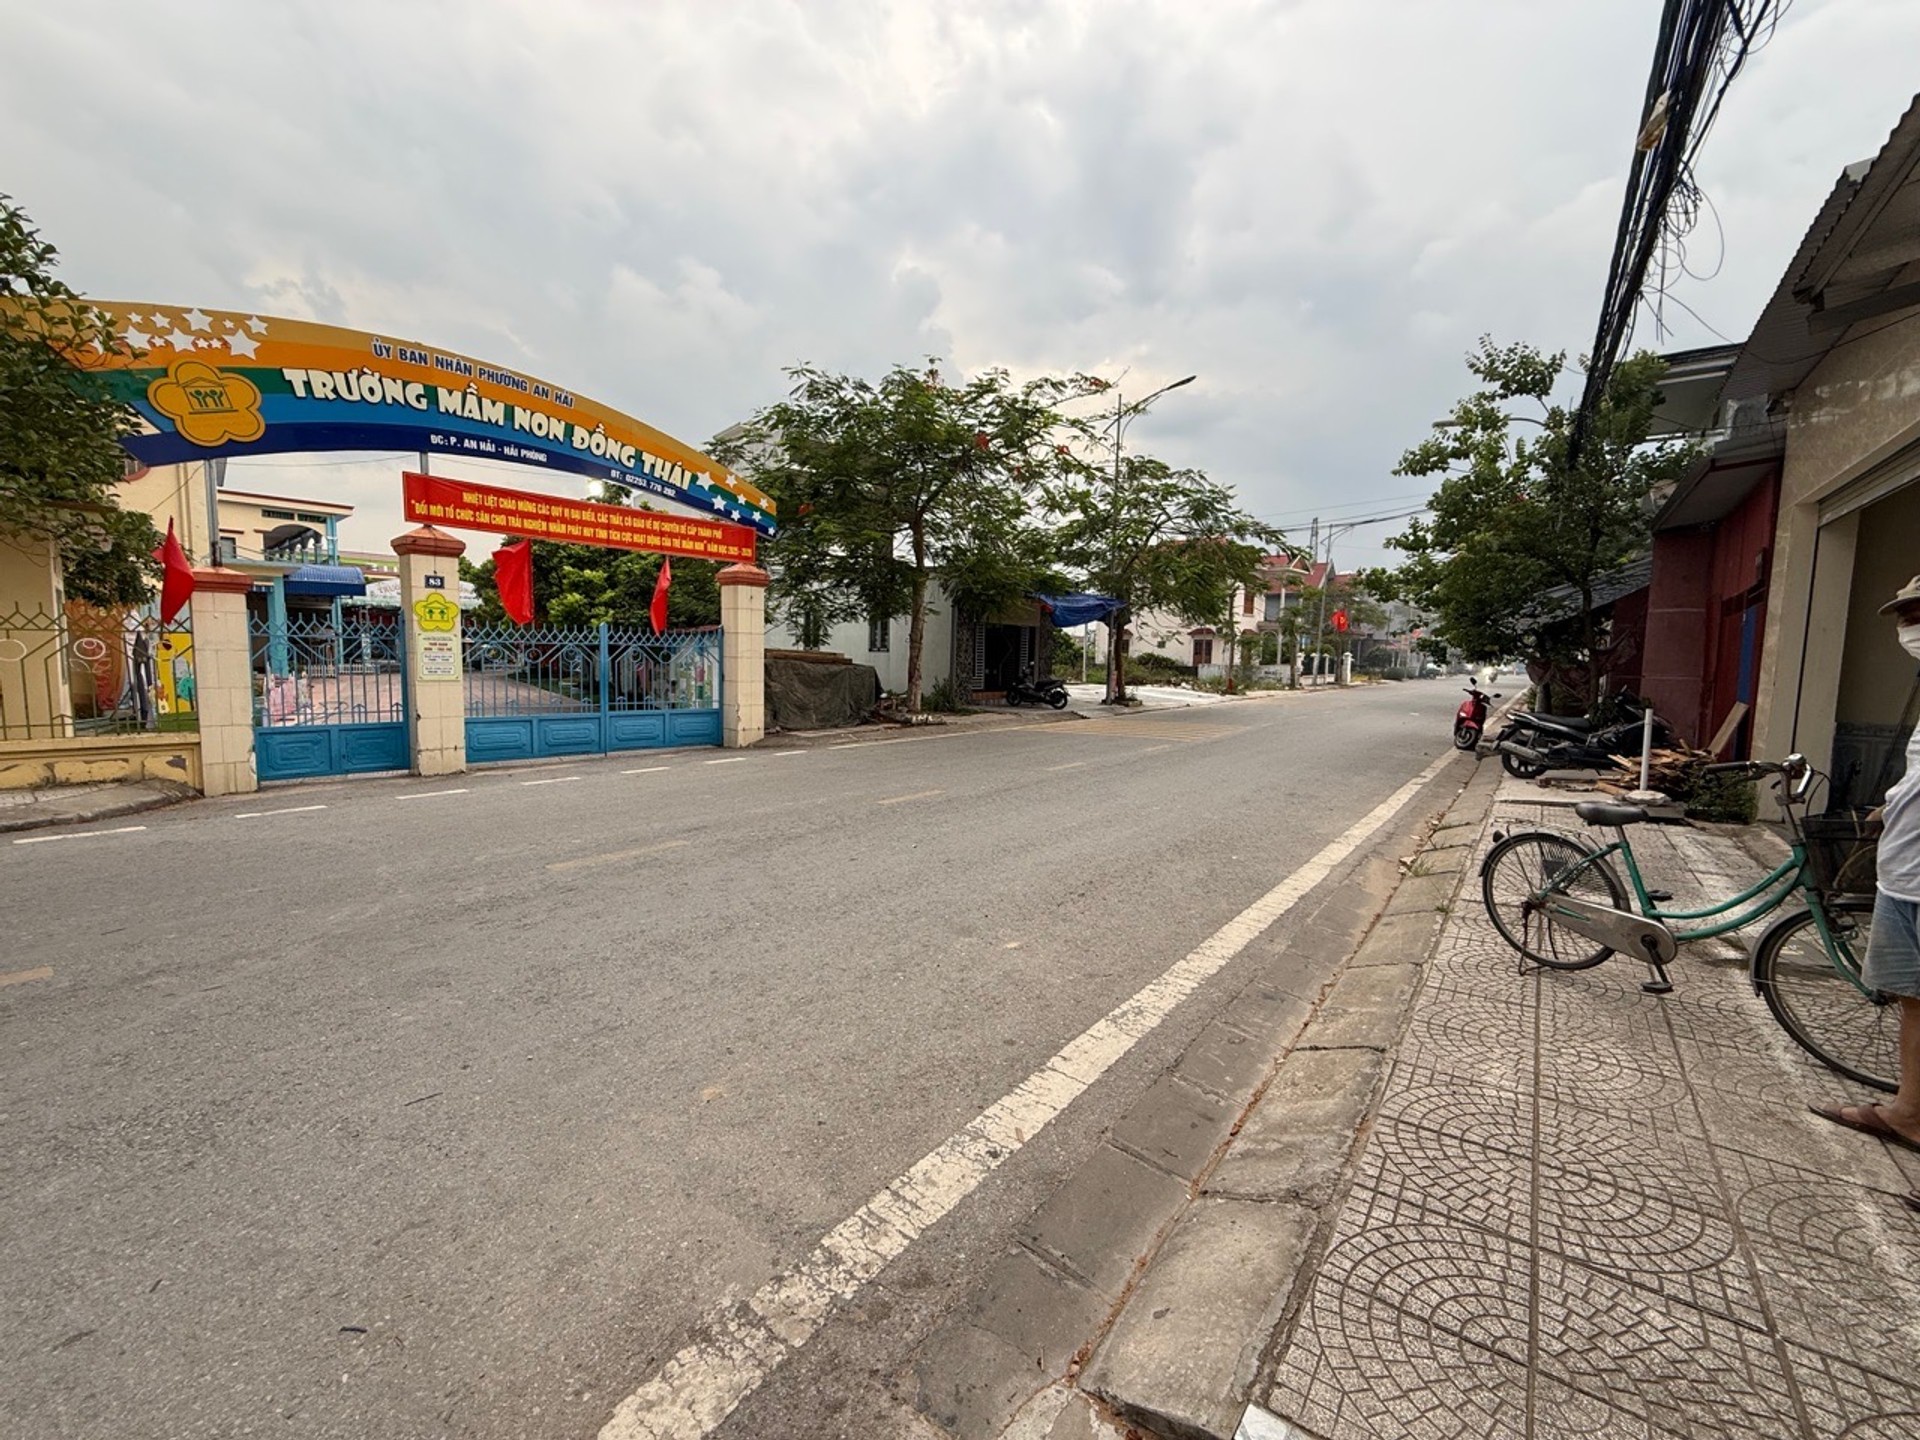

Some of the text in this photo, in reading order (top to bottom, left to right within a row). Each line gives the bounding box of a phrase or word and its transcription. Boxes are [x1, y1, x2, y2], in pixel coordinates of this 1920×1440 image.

[372, 336, 575, 408] ỦY BAN NHÂN PHƯỜNG AN HẢI
[282, 366, 692, 490] TRƯỜNG MẦM NON ĐỒNG THÁI
[463, 439, 478, 450] AN
[479, 440, 496, 453] HẢI
[503, 444, 518, 456] HẢI
